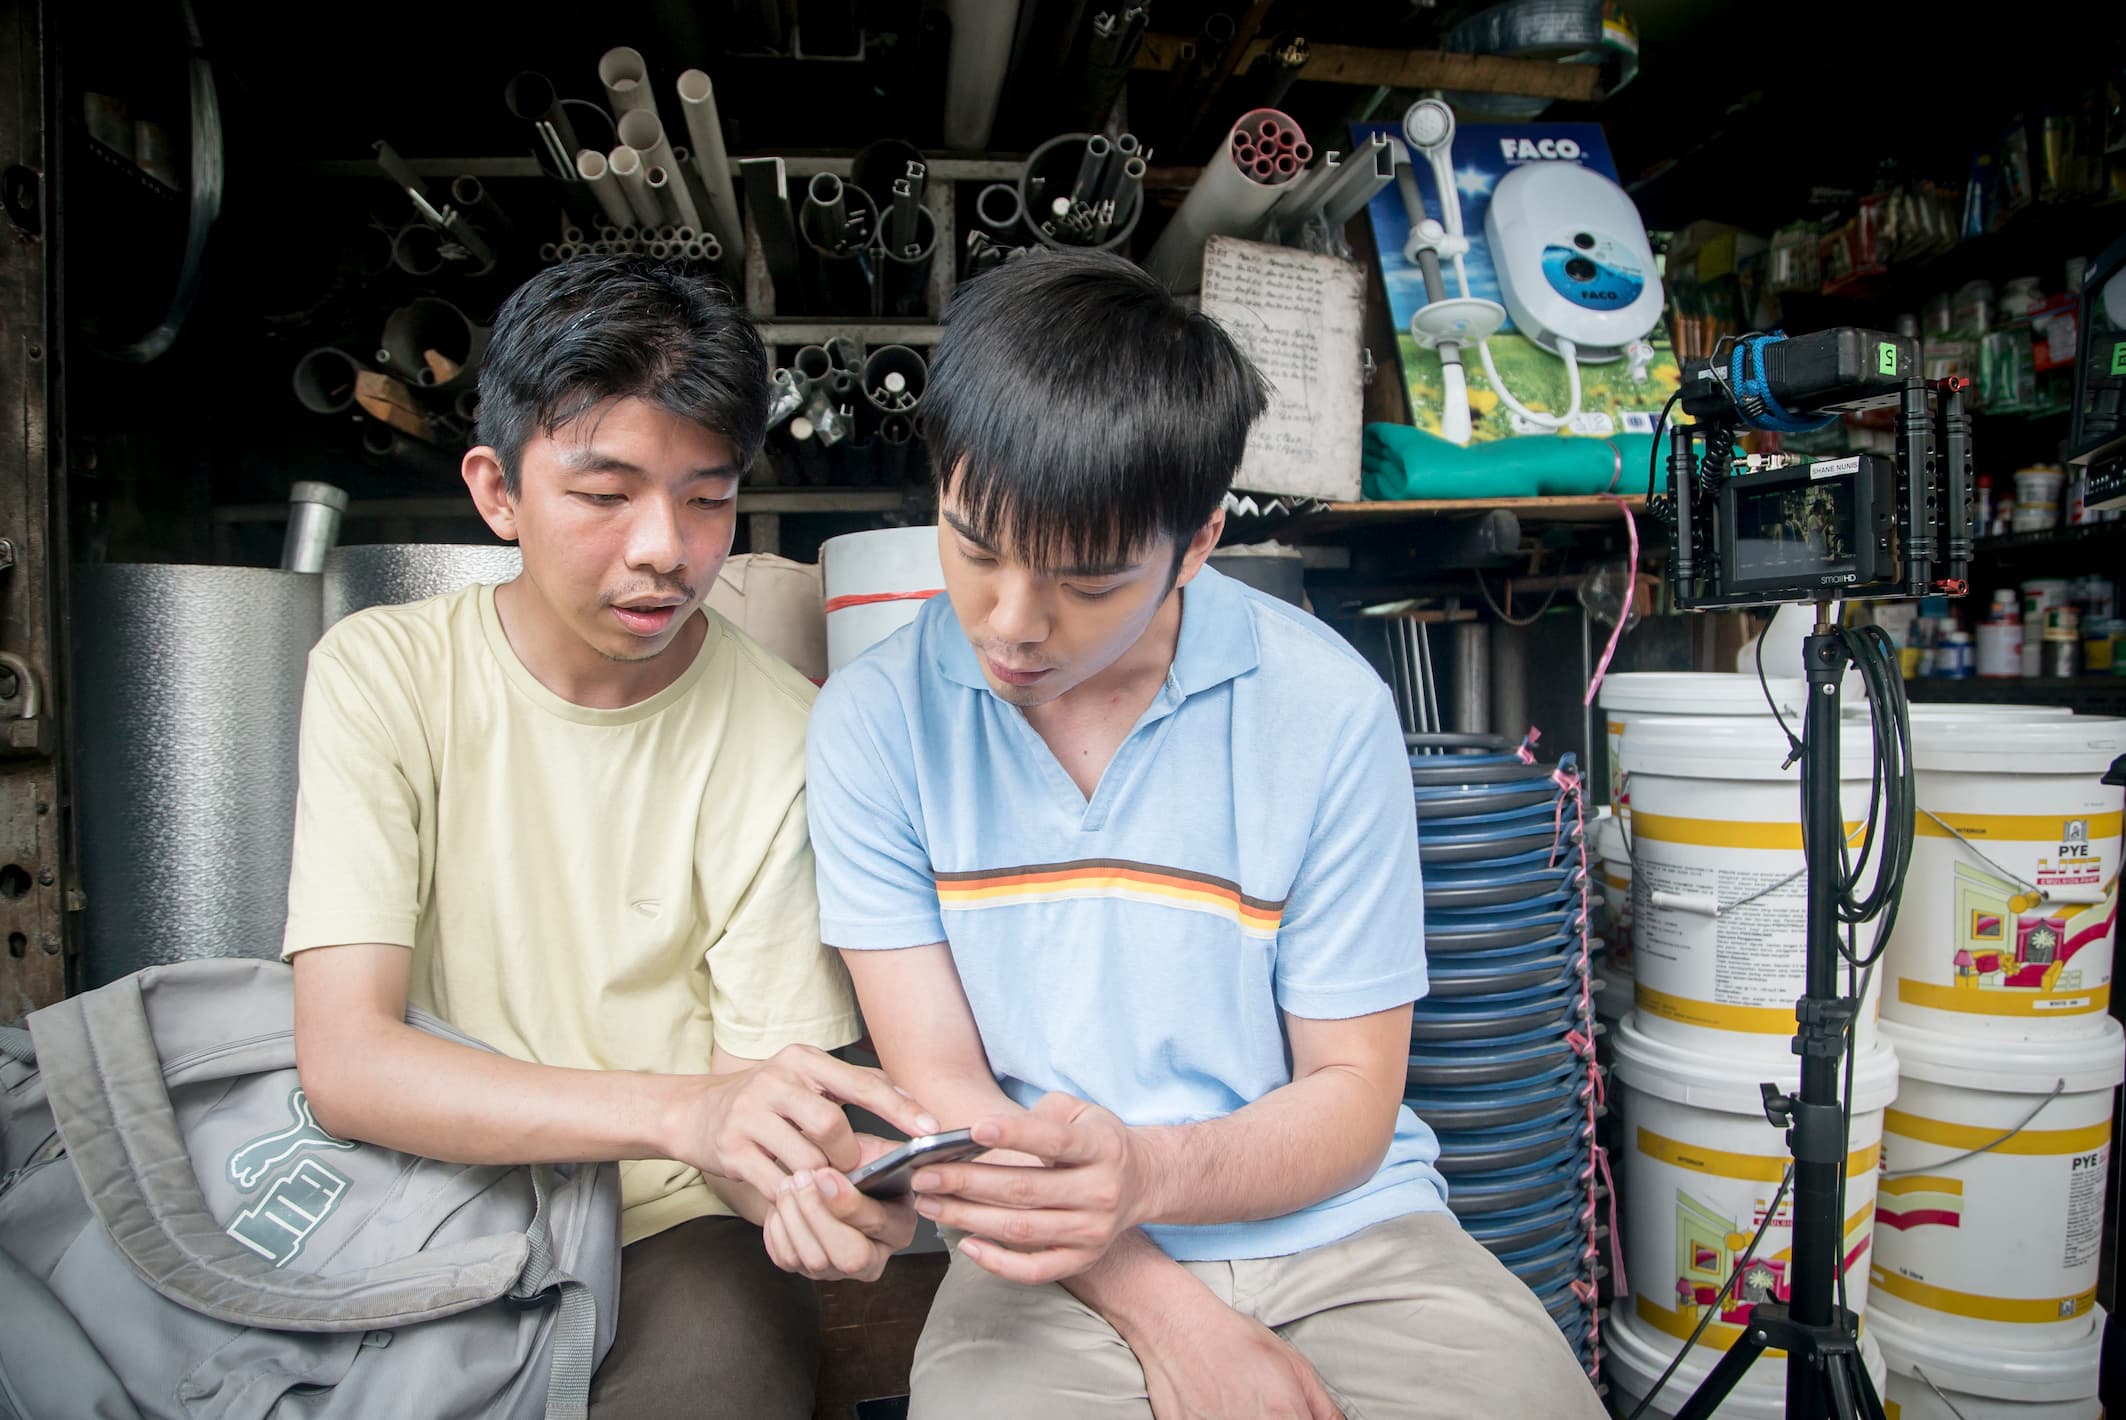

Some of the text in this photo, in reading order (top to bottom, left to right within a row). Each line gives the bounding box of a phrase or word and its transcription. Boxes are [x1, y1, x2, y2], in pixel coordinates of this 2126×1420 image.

[1500, 138, 1581, 160] FACO
[1581, 290, 1618, 301] FACO
[1812, 461, 1858, 475] SHANE NUNIS
[1820, 573, 1857, 584] smallHD
[2058, 844, 2089, 857] PYE
[2072, 1153, 2098, 1171] PYE
